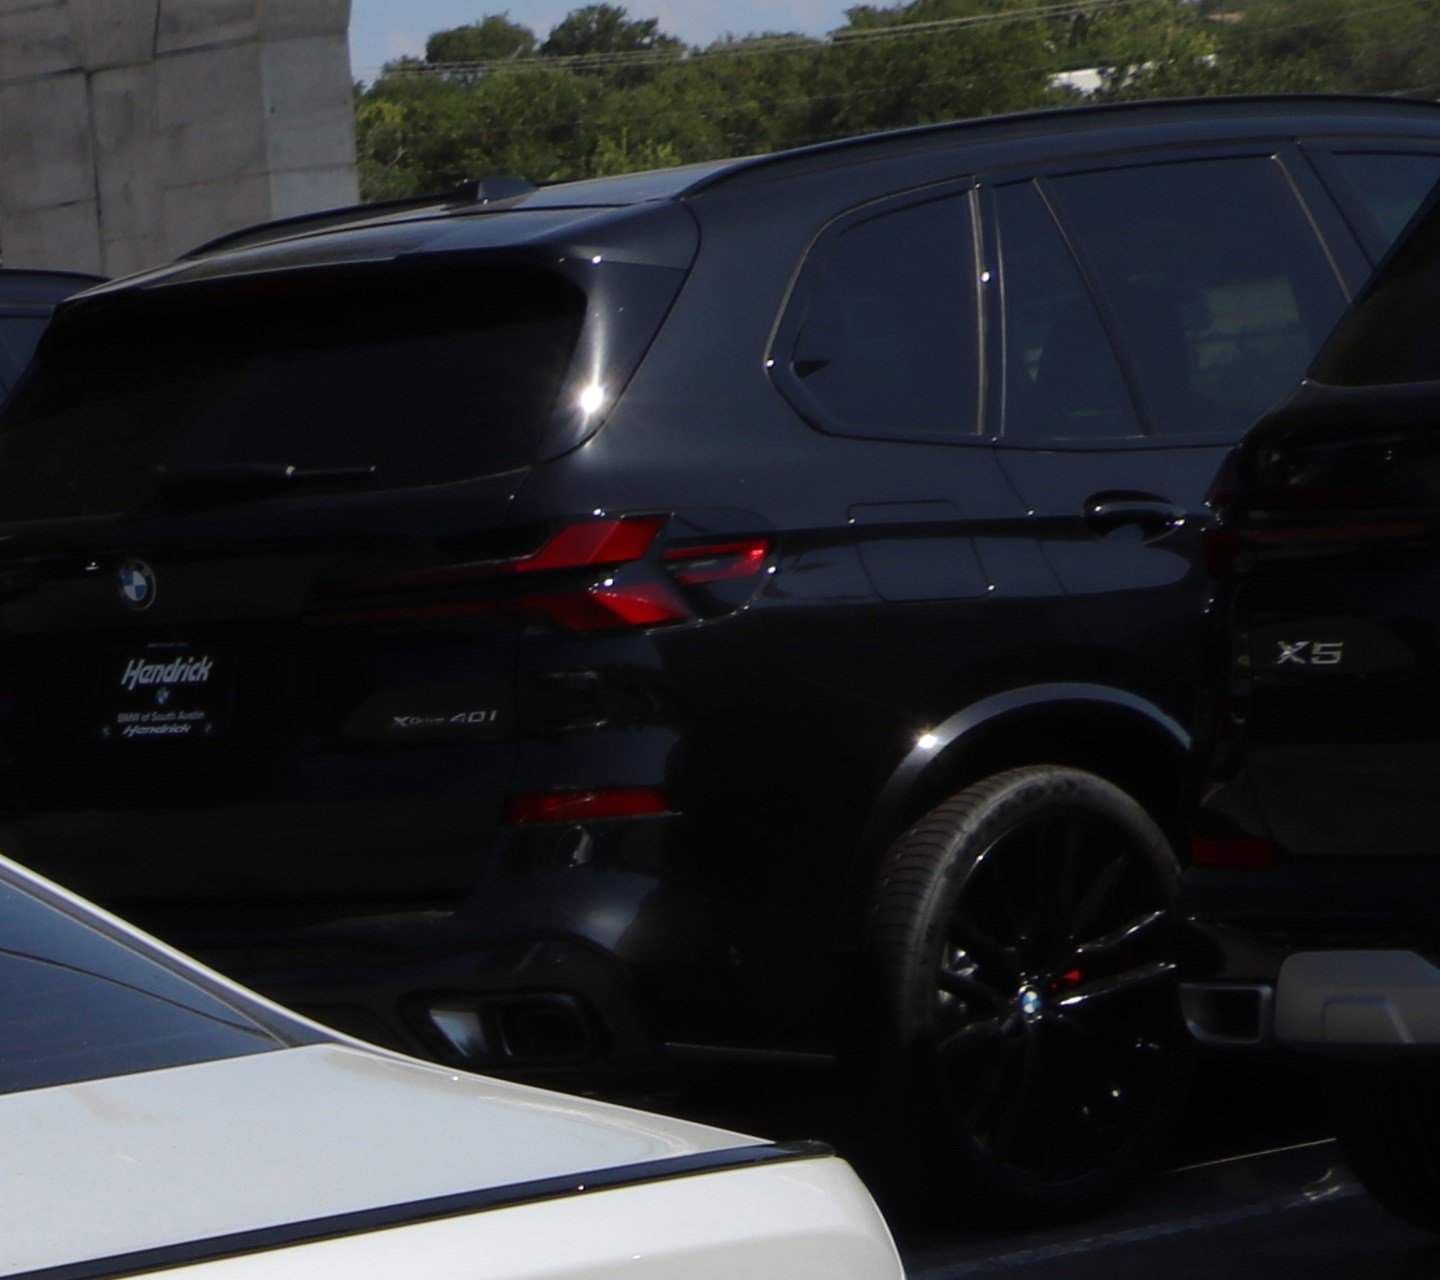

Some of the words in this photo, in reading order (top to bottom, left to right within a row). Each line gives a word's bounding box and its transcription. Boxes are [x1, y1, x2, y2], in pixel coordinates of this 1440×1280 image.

[1277, 641, 1343, 664] X5
[121, 656, 213, 690] Hendrick
[118, 713, 139, 723] BMW
[152, 711, 176, 722] South
[178, 710, 205, 721] Austin
[122, 723, 192, 737] Hendrick
